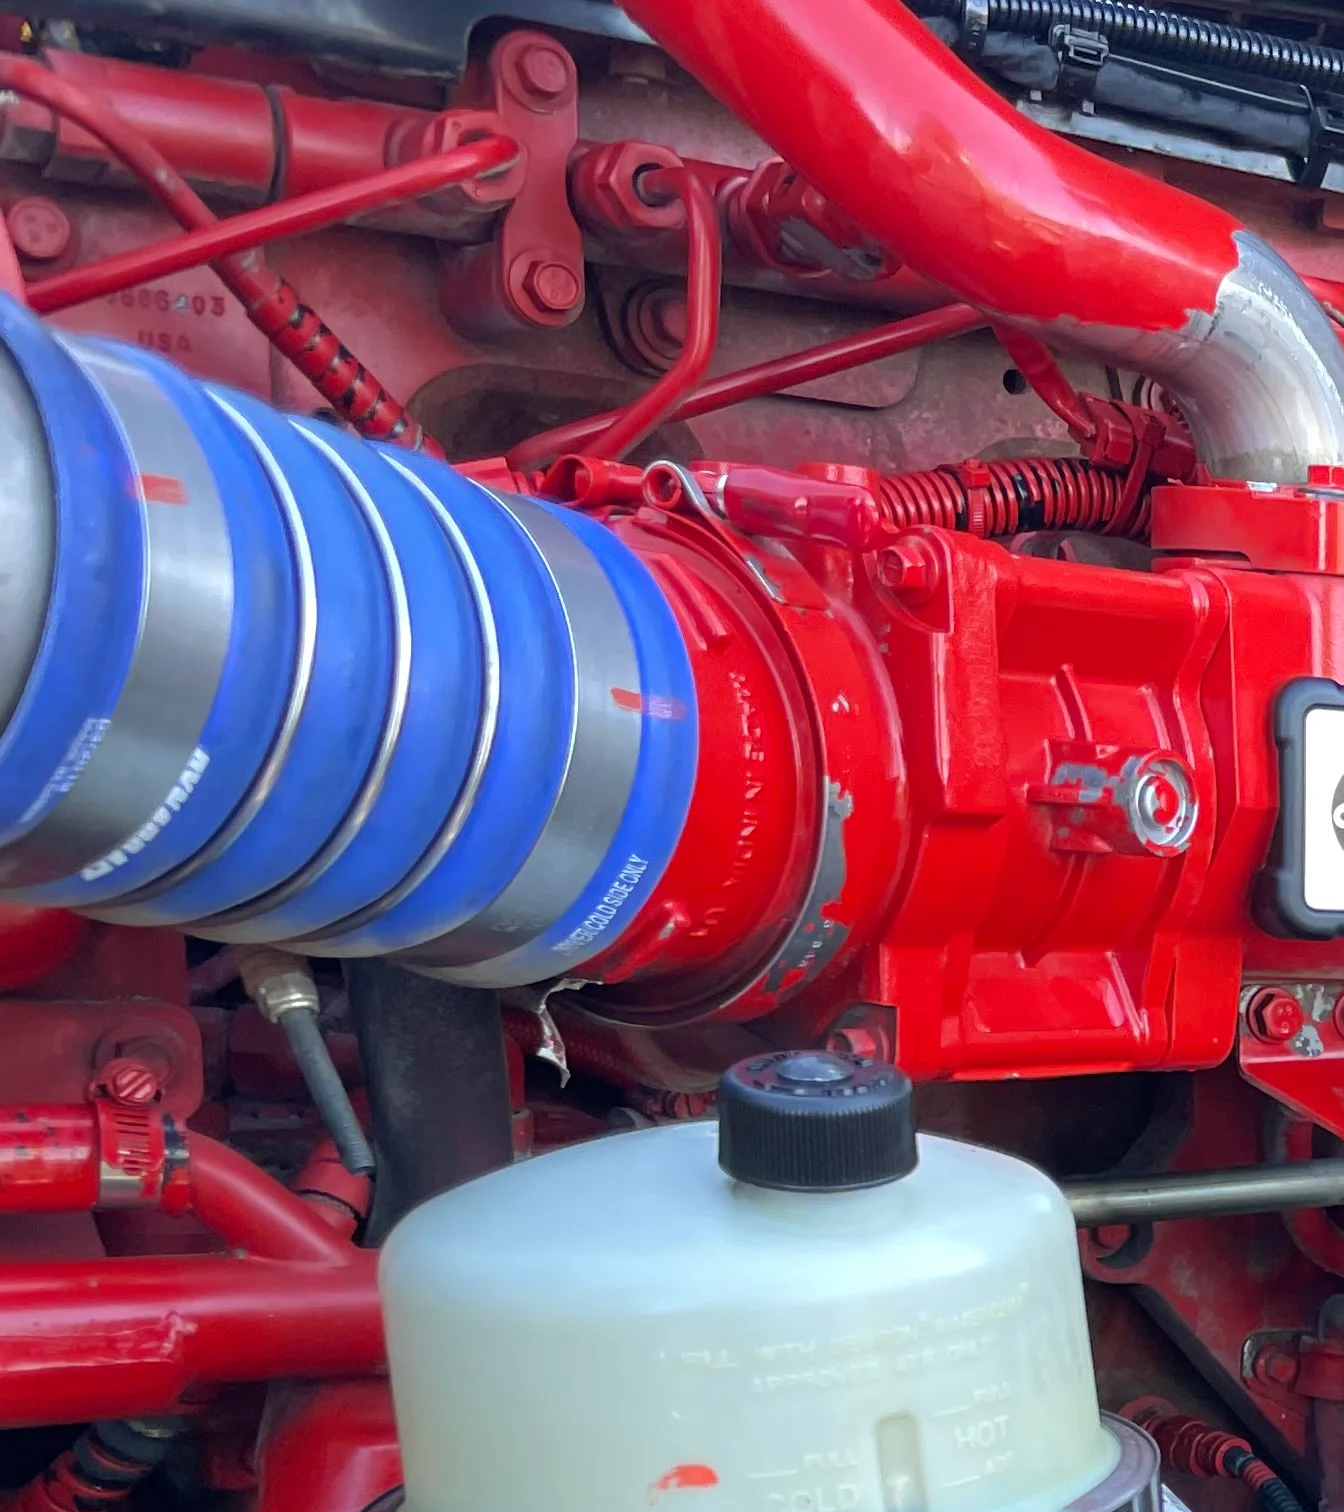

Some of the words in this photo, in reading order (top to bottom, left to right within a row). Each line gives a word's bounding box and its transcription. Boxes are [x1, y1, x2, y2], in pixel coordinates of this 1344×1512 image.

[603, 881, 634, 907] SIDE
[619, 853, 649, 884] ONLY
[954, 1415, 1010, 1450] HOT
